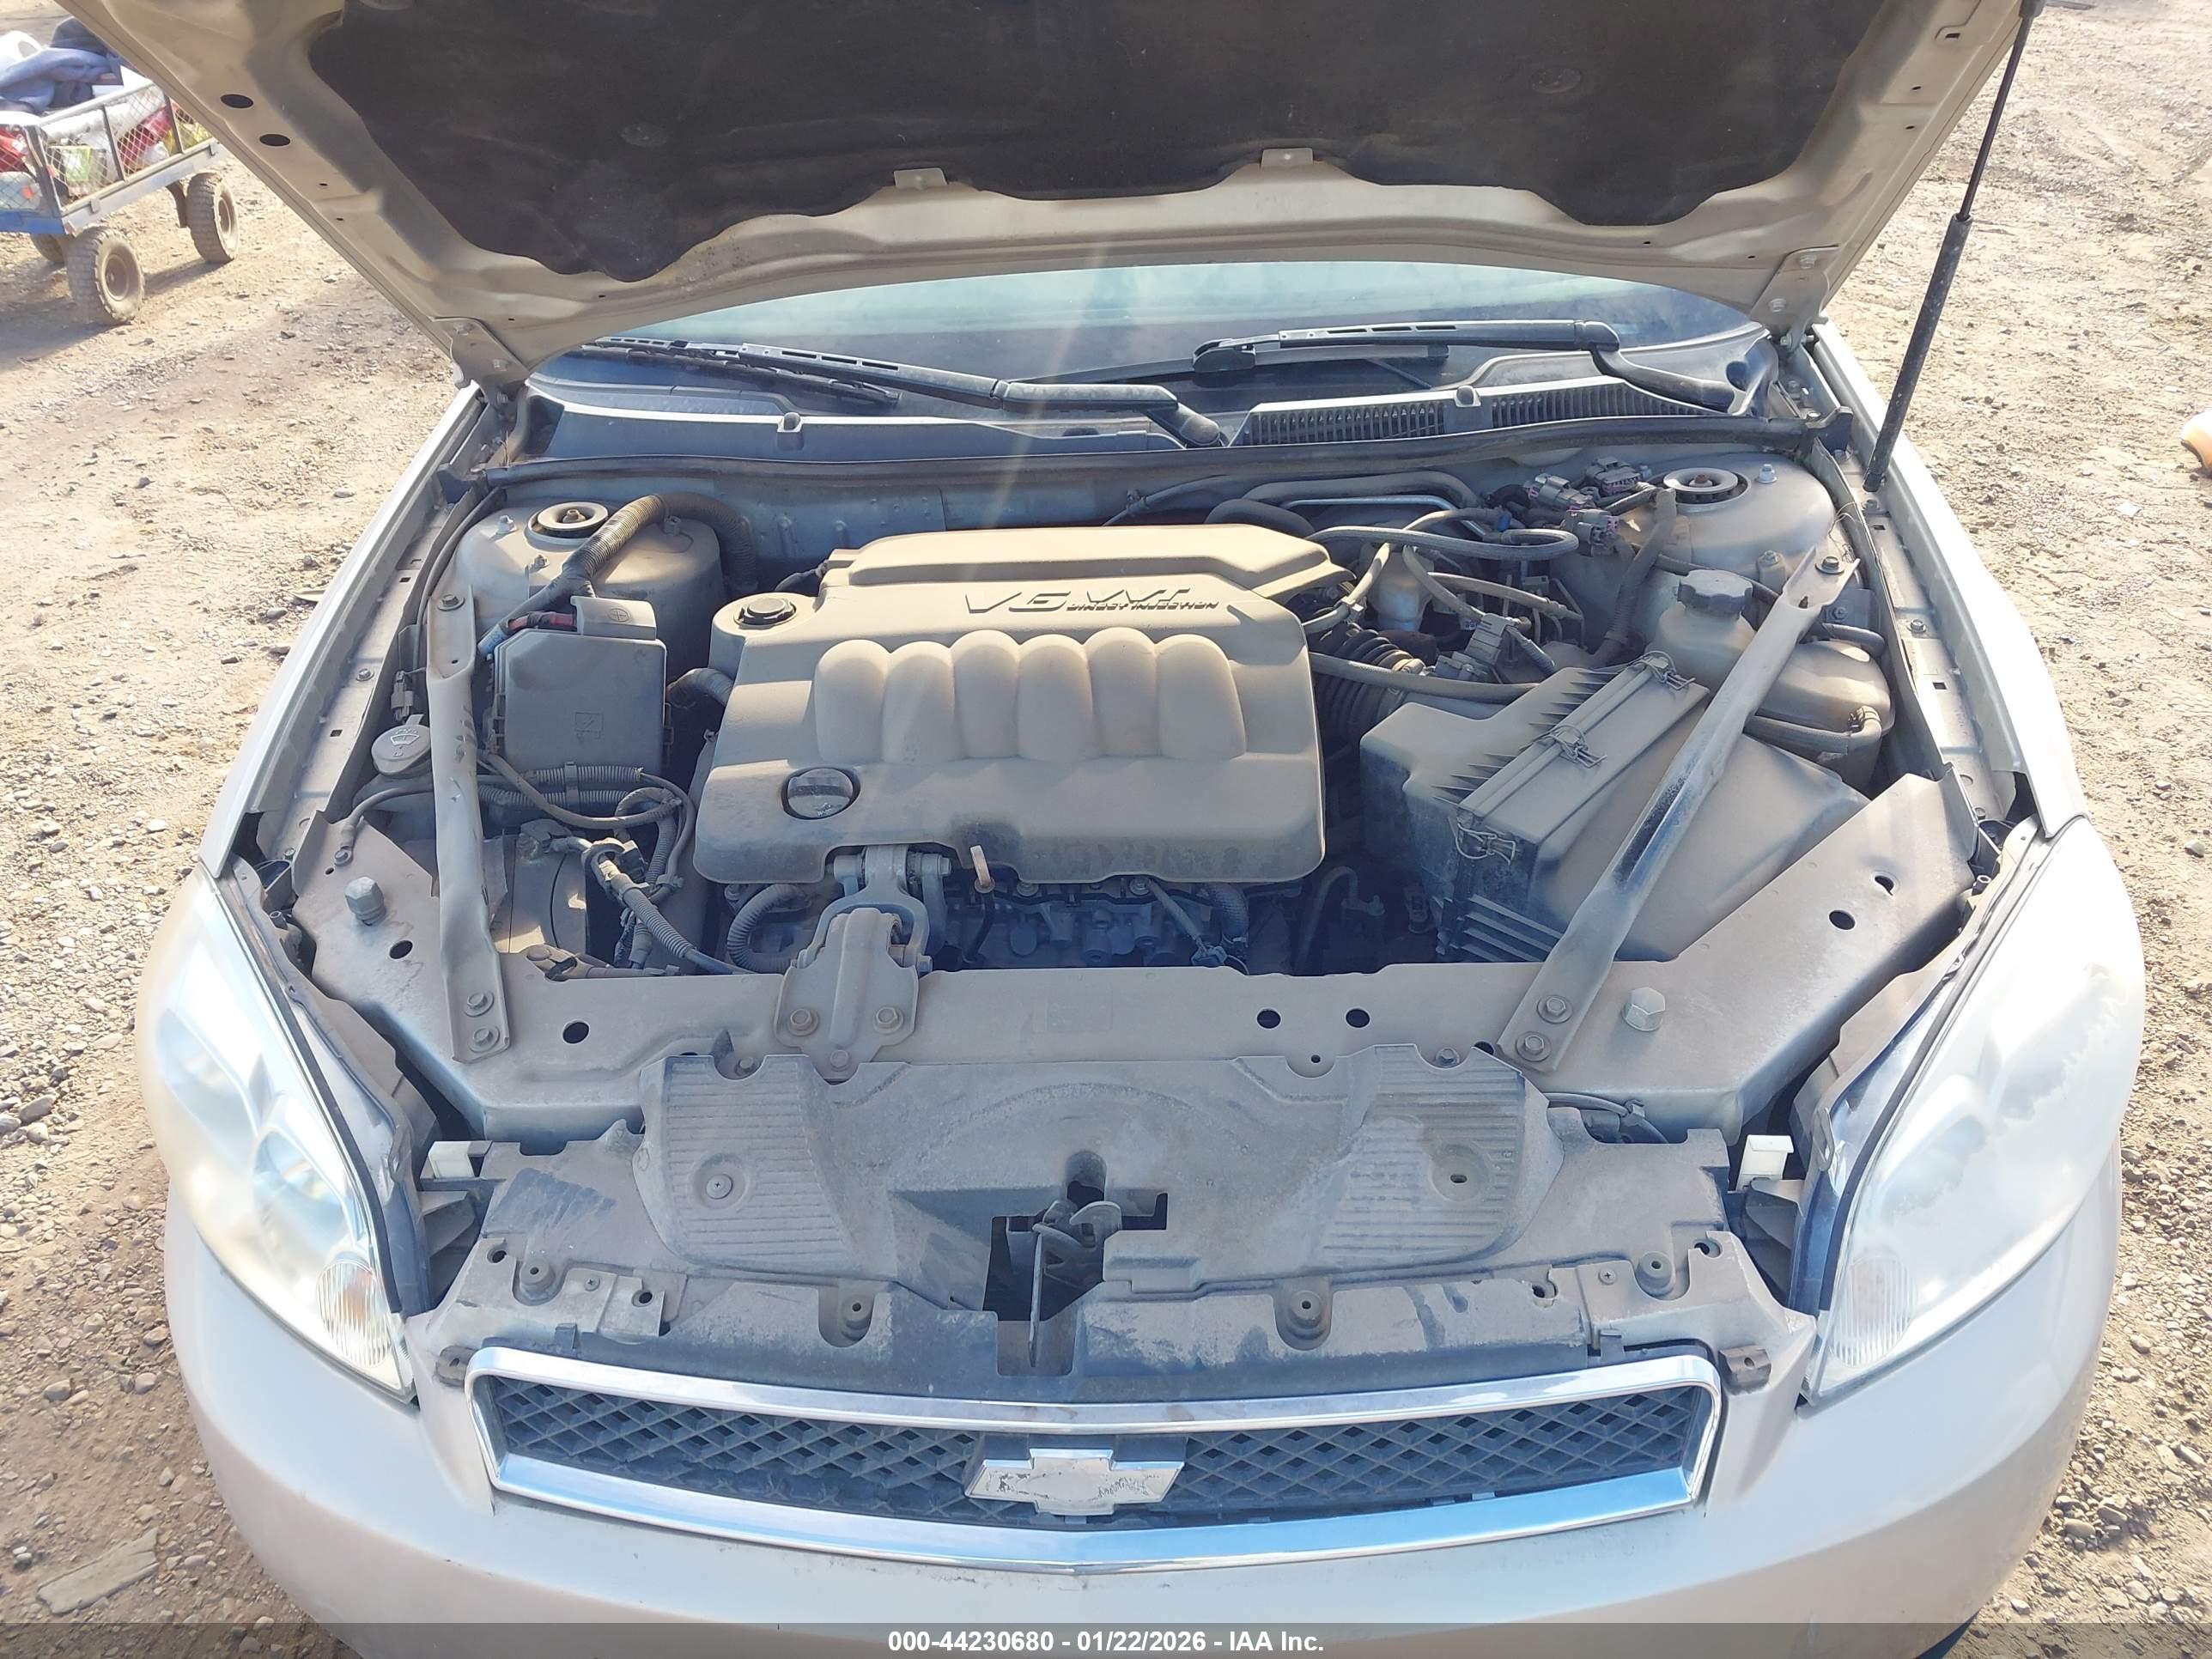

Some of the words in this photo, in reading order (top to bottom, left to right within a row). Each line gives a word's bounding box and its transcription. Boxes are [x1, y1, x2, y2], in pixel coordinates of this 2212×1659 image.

[964, 591, 1072, 614] V6
[1066, 603, 1129, 611] DIRECT
[1130, 601, 1219, 611] INJECTION
